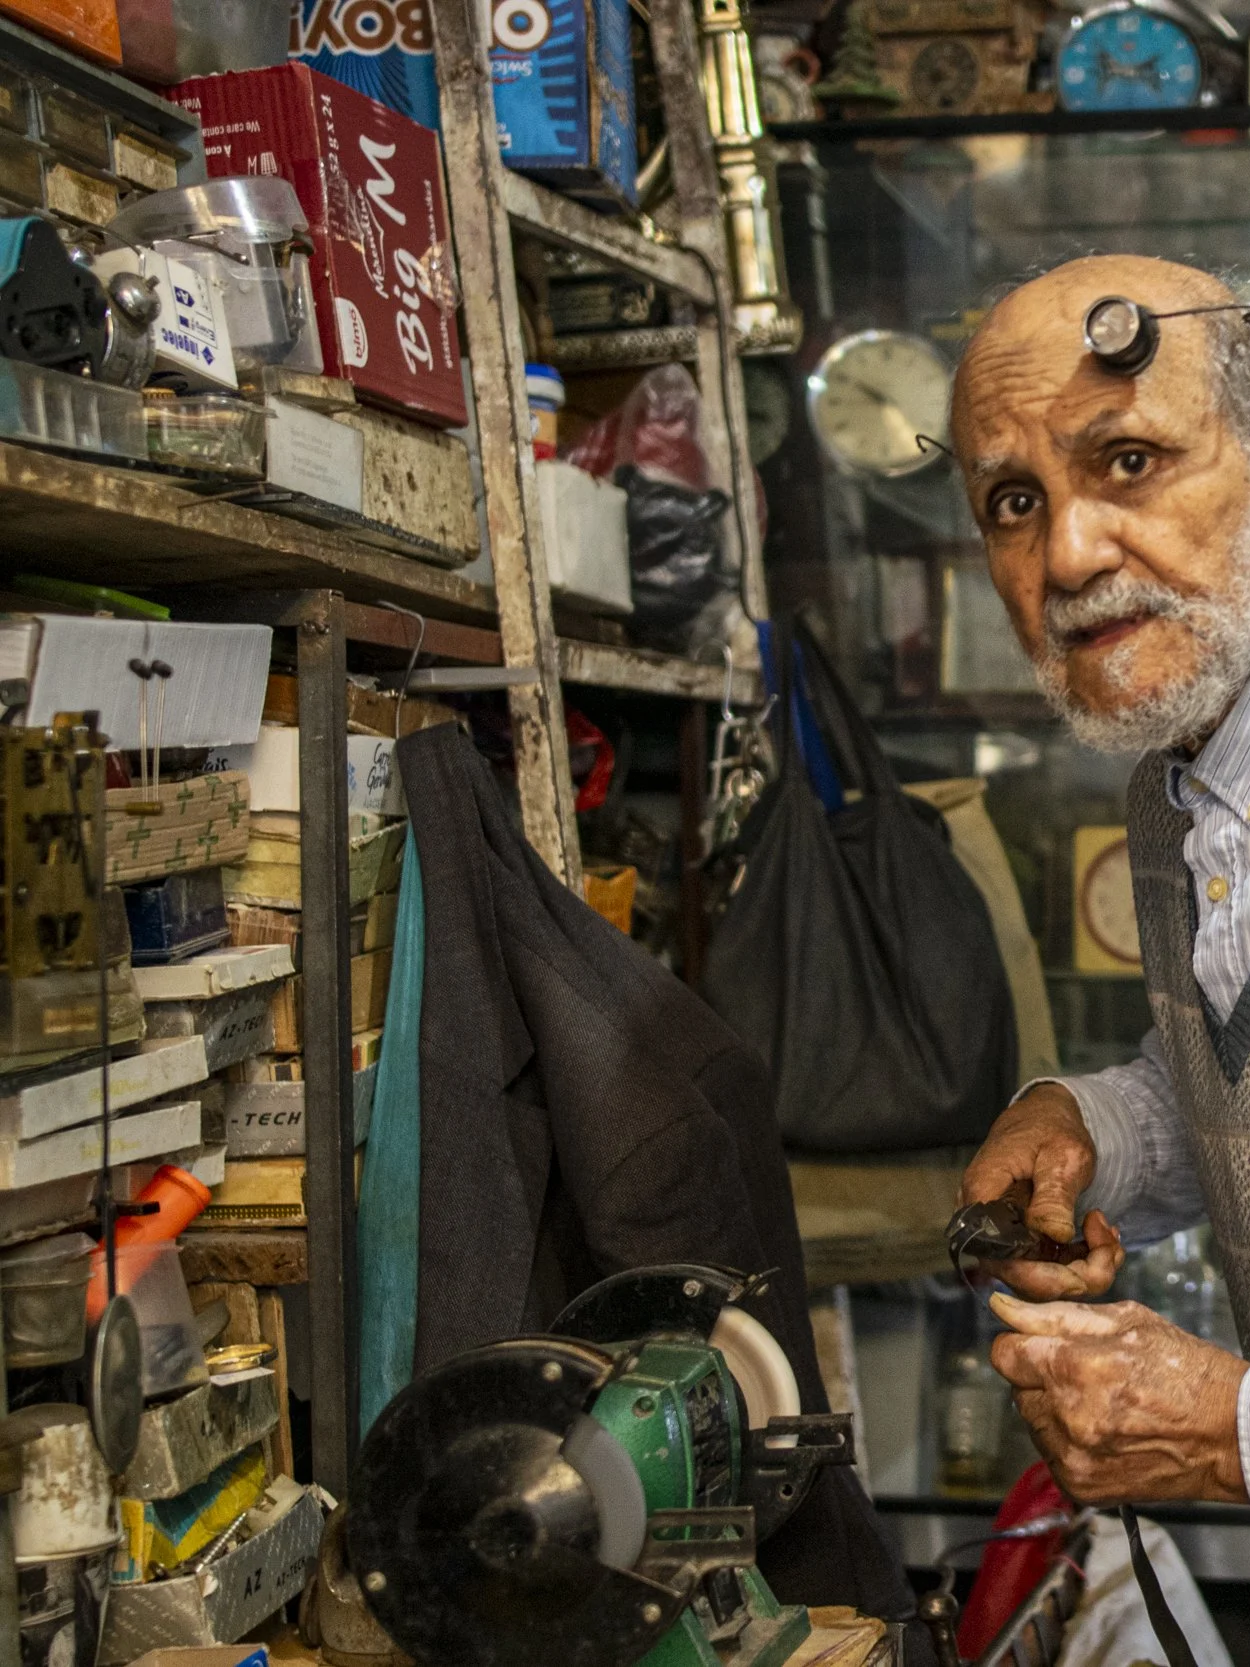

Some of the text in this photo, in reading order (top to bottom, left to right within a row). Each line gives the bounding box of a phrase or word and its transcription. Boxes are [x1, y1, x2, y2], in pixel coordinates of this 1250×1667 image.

[320, 94, 333, 119] 24
[226, 121, 245, 134] care
[245, 120, 261, 133] We
[359, 134, 406, 226] M
[393, 248, 434, 375] Big
[161, 327, 200, 361] ingelec
[243, 1567, 262, 1600] AZ
